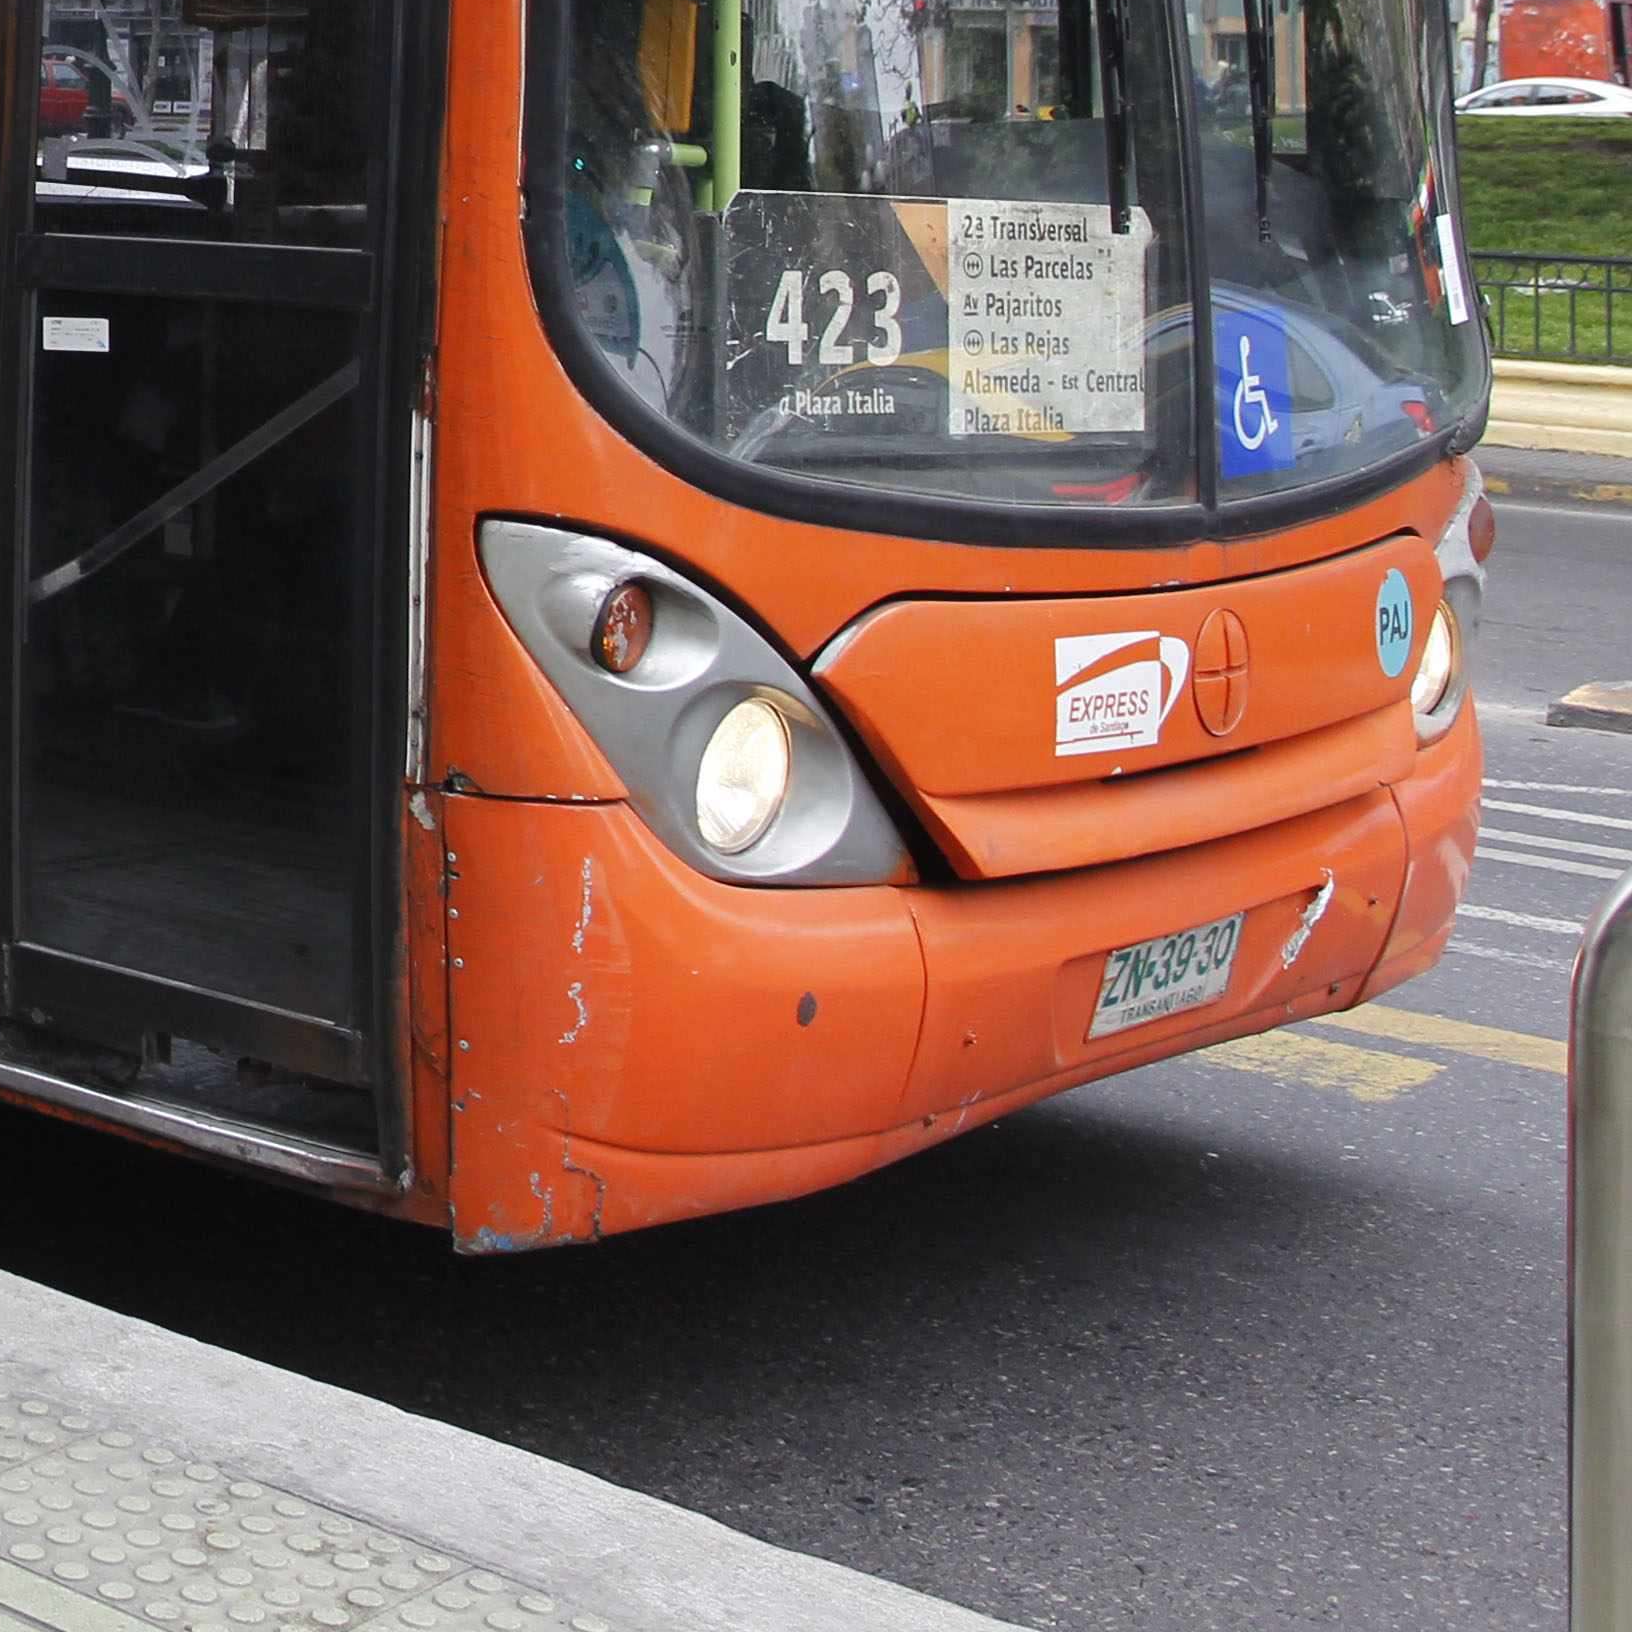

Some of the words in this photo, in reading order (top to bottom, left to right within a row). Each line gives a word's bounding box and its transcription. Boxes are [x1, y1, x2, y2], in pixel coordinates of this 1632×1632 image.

[990, 215, 1088, 243] Transversal
[990, 254, 1018, 279] Las
[1024, 254, 1094, 280] Parcelas
[765, 269, 904, 367] 423
[964, 293, 979, 316] Av
[985, 290, 1063, 324] Pajaritos
[990, 331, 1018, 356] Las
[1025, 329, 1070, 361] Rejas
[963, 368, 1041, 395] Alameda
[1062, 374, 1079, 390] Est
[1086, 369, 1145, 394] Central
[795, 391, 841, 417] Plaza
[847, 387, 895, 416] Italia
[964, 407, 1011, 433] Plaza
[1017, 406, 1064, 432] Italia
[1378, 599, 1410, 647] PAJ
[1069, 689, 1150, 724] EXPRESS
